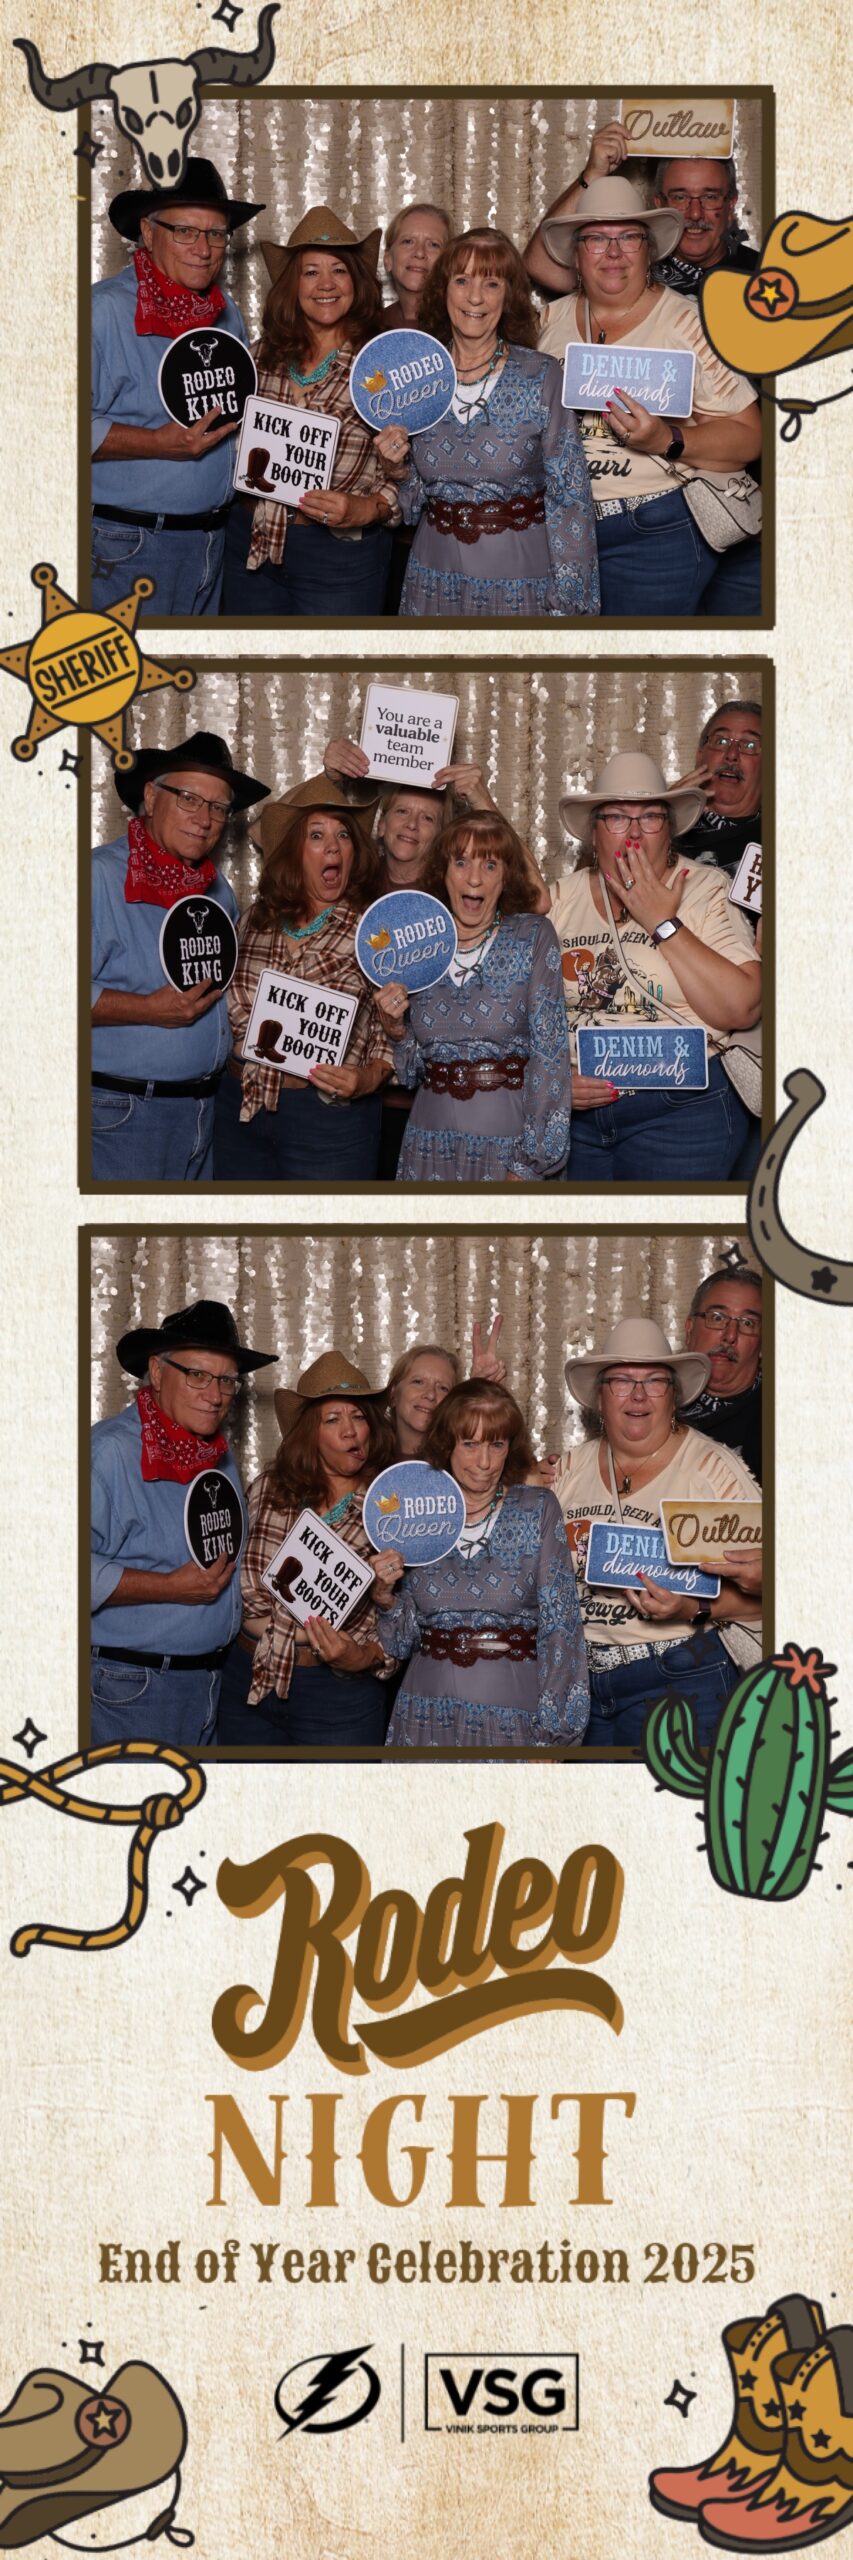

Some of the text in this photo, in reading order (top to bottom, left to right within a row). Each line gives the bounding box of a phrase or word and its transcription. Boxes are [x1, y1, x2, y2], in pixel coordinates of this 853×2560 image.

[624, 109, 730, 141] Outlaw
[182, 366, 236, 396] RODEO
[388, 353, 444, 390] RODEO
[581, 353, 677, 382] DENIM &
[186, 390, 239, 421] KING
[368, 378, 450, 420] Queen
[253, 411, 332, 449] KICK OFF
[285, 443, 327, 472] YOUR
[271, 462, 324, 490] BOOTS
[377, 706, 443, 729] You are a
[376, 724, 440, 743] valuable
[387, 738, 424, 755] team
[373, 752, 434, 771] member
[393, 915, 447, 950] RODEO
[621, 931, 650, 945] BEEN
[179, 935, 221, 961] RODEO
[372, 940, 450, 977] Queen
[182, 959, 222, 985] KING
[267, 984, 349, 1026] KICK OFF
[299, 1017, 342, 1047] YOUR
[593, 1035, 689, 1058] DENIM &
[281, 1034, 337, 1065] BOOTS
[594, 1049, 690, 1085] diamonds
[404, 1495, 457, 1519] RODEO
[622, 1504, 653, 1523] BEEN
[200, 1508, 231, 1537] RODEO
[376, 1514, 457, 1544] Queen
[203, 1532, 234, 1562] KING
[299, 1525, 363, 1593] KICK OFF
[294, 1577, 340, 1627] BOOTS
[313, 1568, 350, 1611] YOUR
